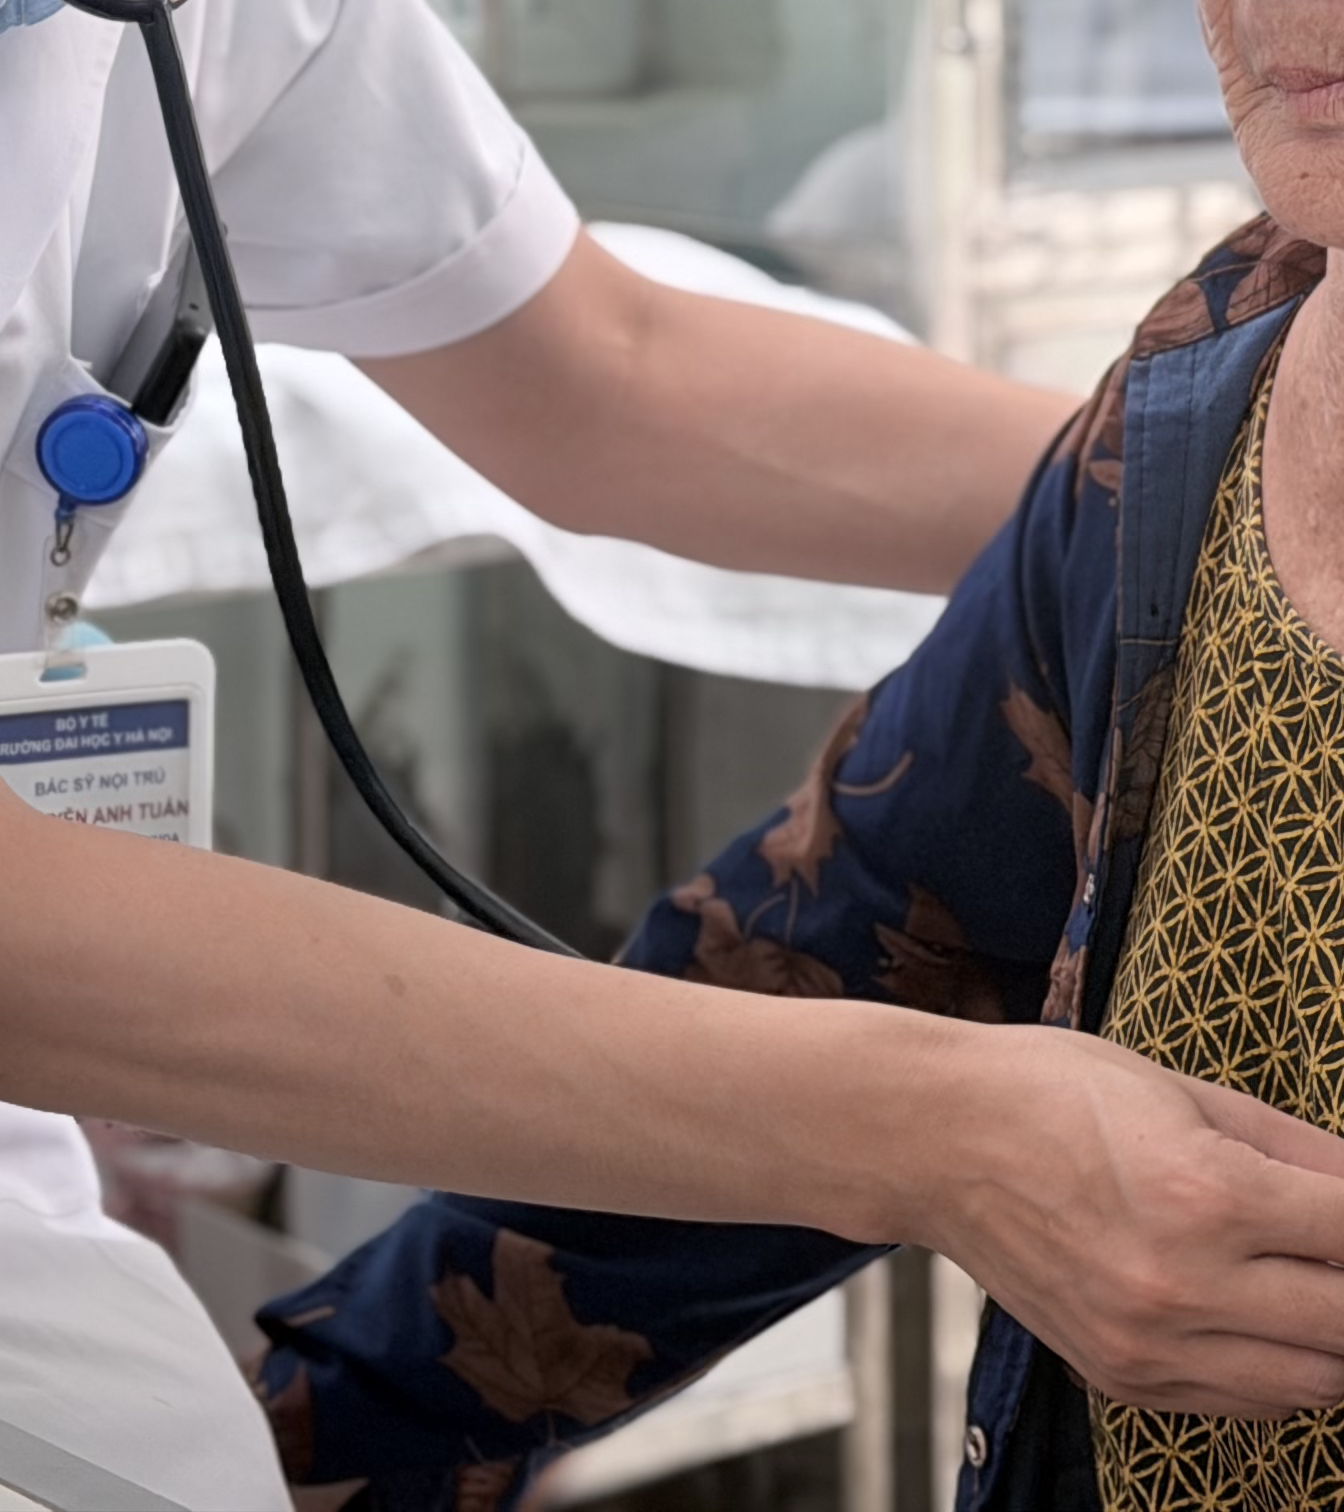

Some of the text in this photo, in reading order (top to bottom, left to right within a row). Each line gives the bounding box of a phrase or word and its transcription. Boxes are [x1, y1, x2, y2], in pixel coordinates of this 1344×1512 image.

[79, 715, 89, 729] Y
[113, 731, 123, 744] Y
[34, 778, 69, 797] BÁC
[93, 804, 133, 825] ANH
